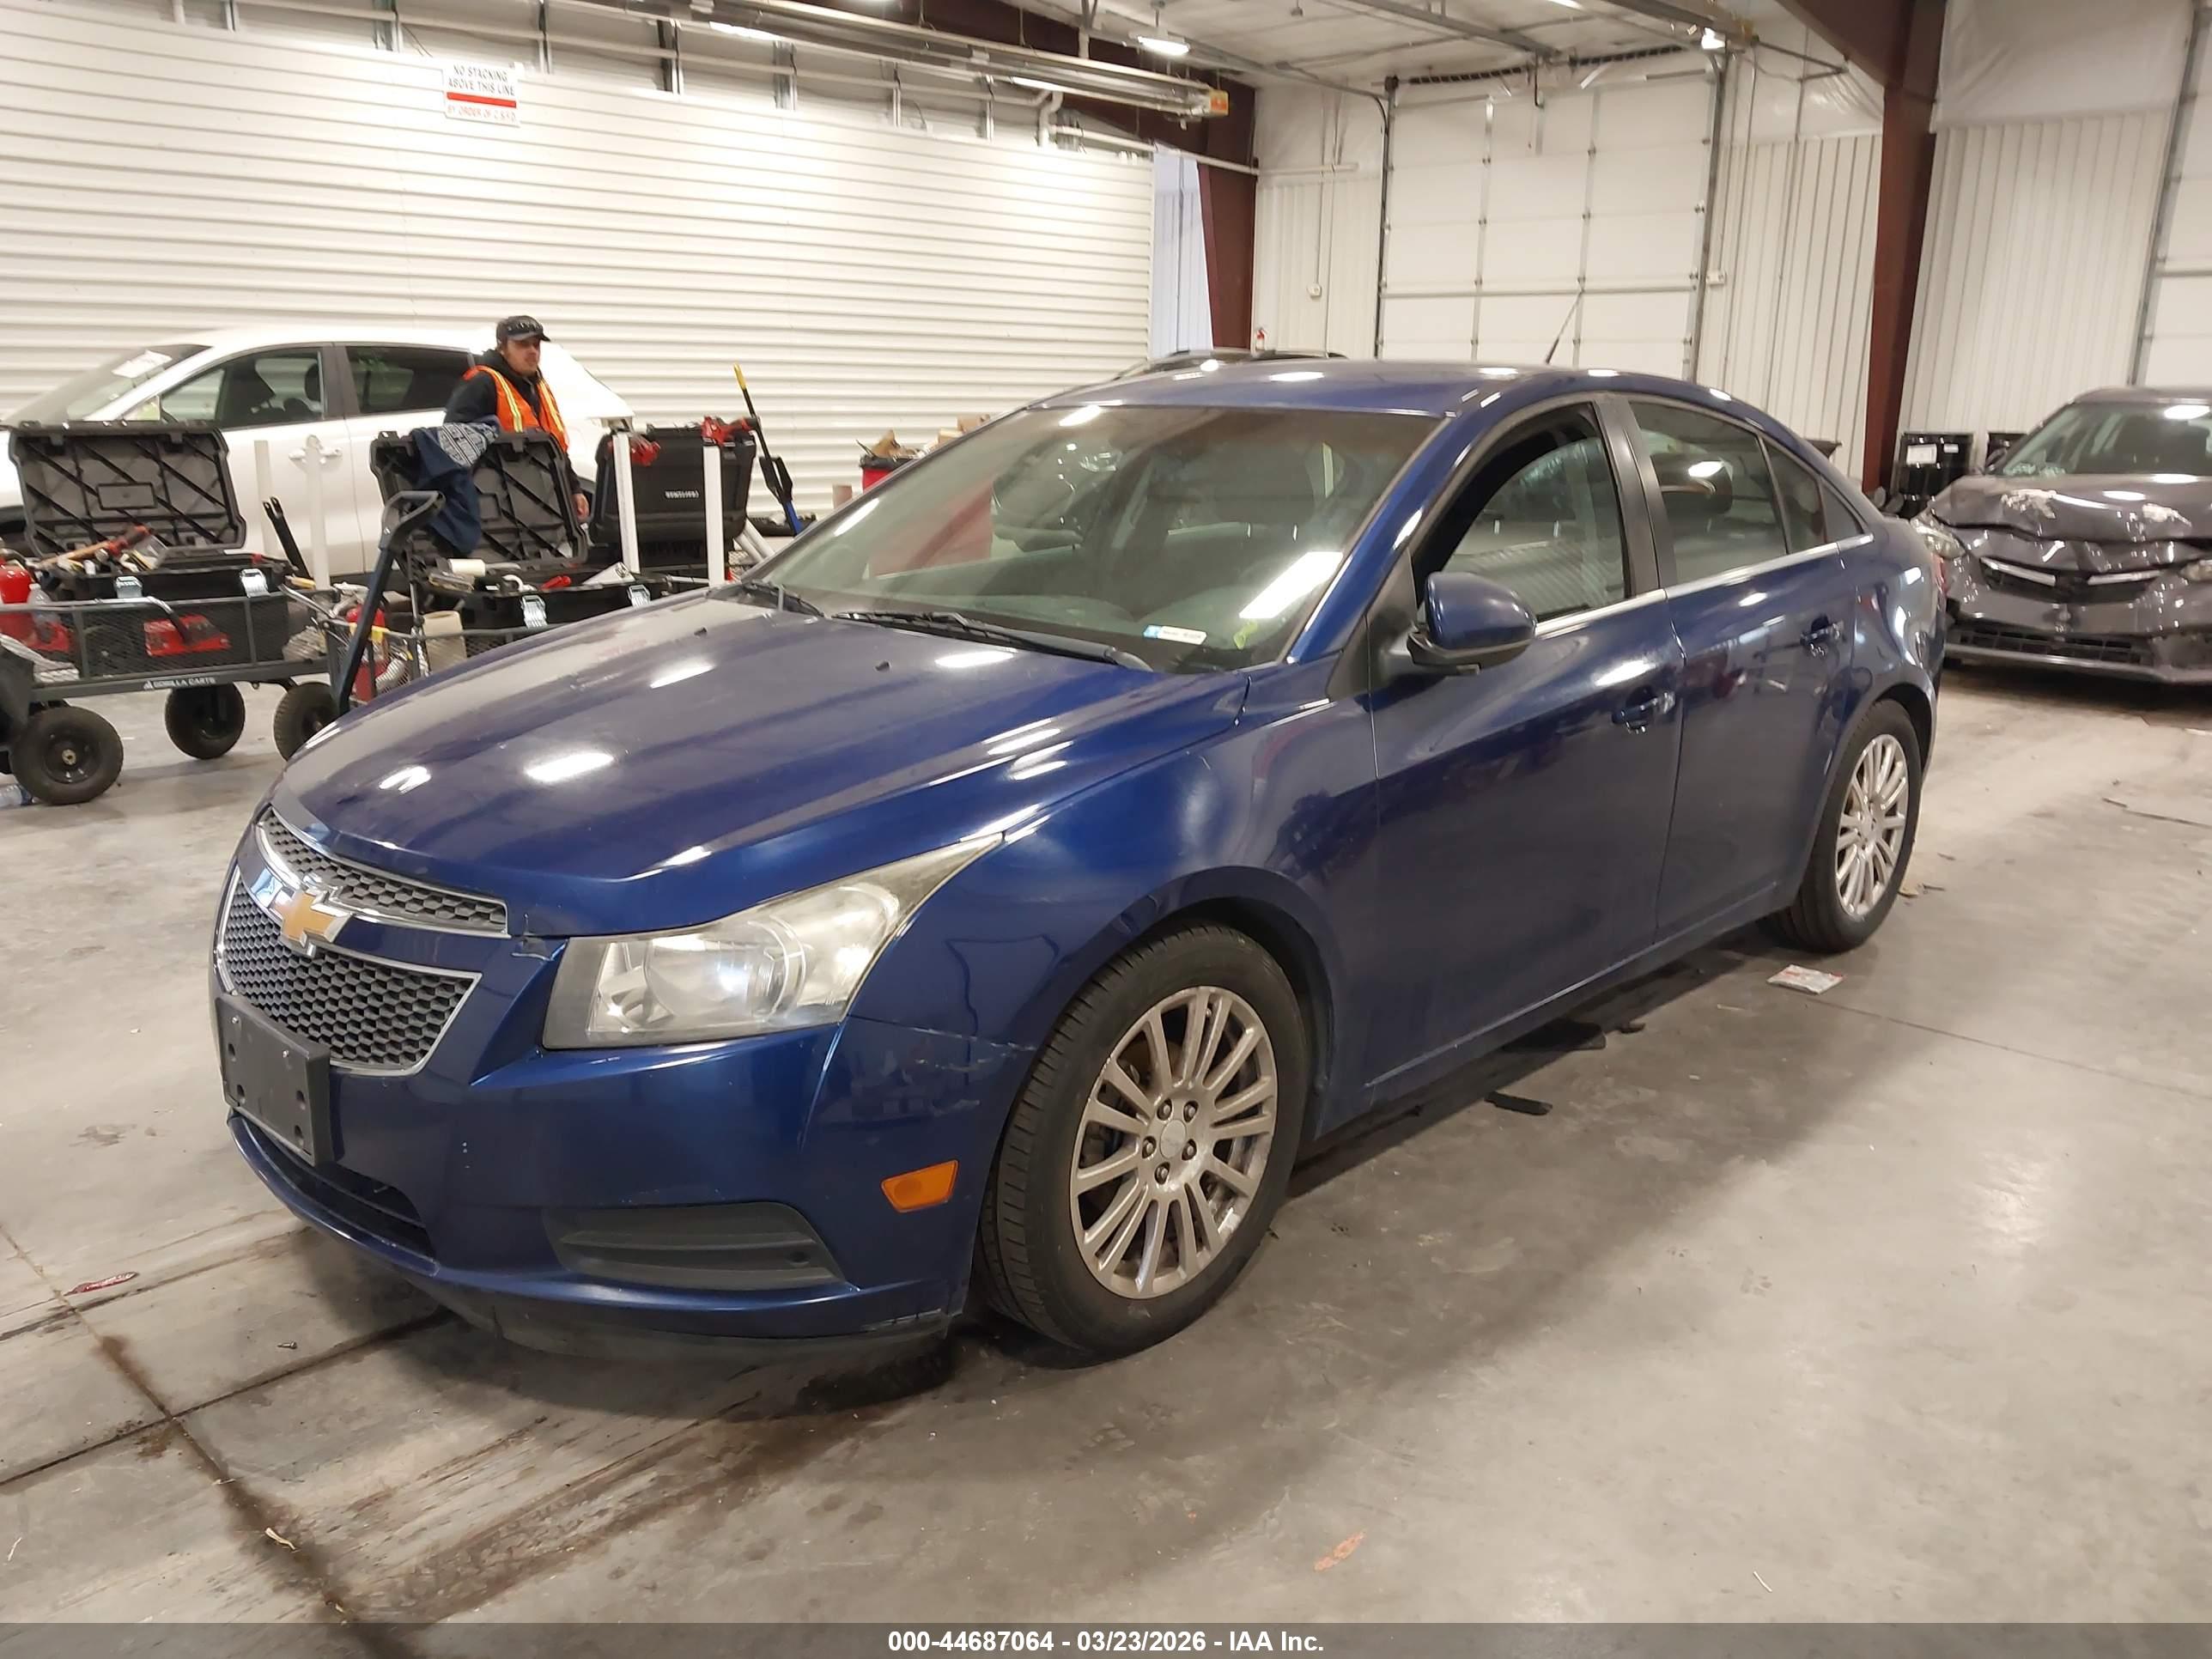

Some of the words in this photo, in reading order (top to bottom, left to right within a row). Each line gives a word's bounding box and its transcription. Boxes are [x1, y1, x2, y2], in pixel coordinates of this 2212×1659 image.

[453, 64, 465, 76] NO
[467, 66, 508, 83] STACKING
[448, 77, 475, 90] ABOVE
[477, 81, 495, 94] THIS
[497, 83, 515, 96] LINE
